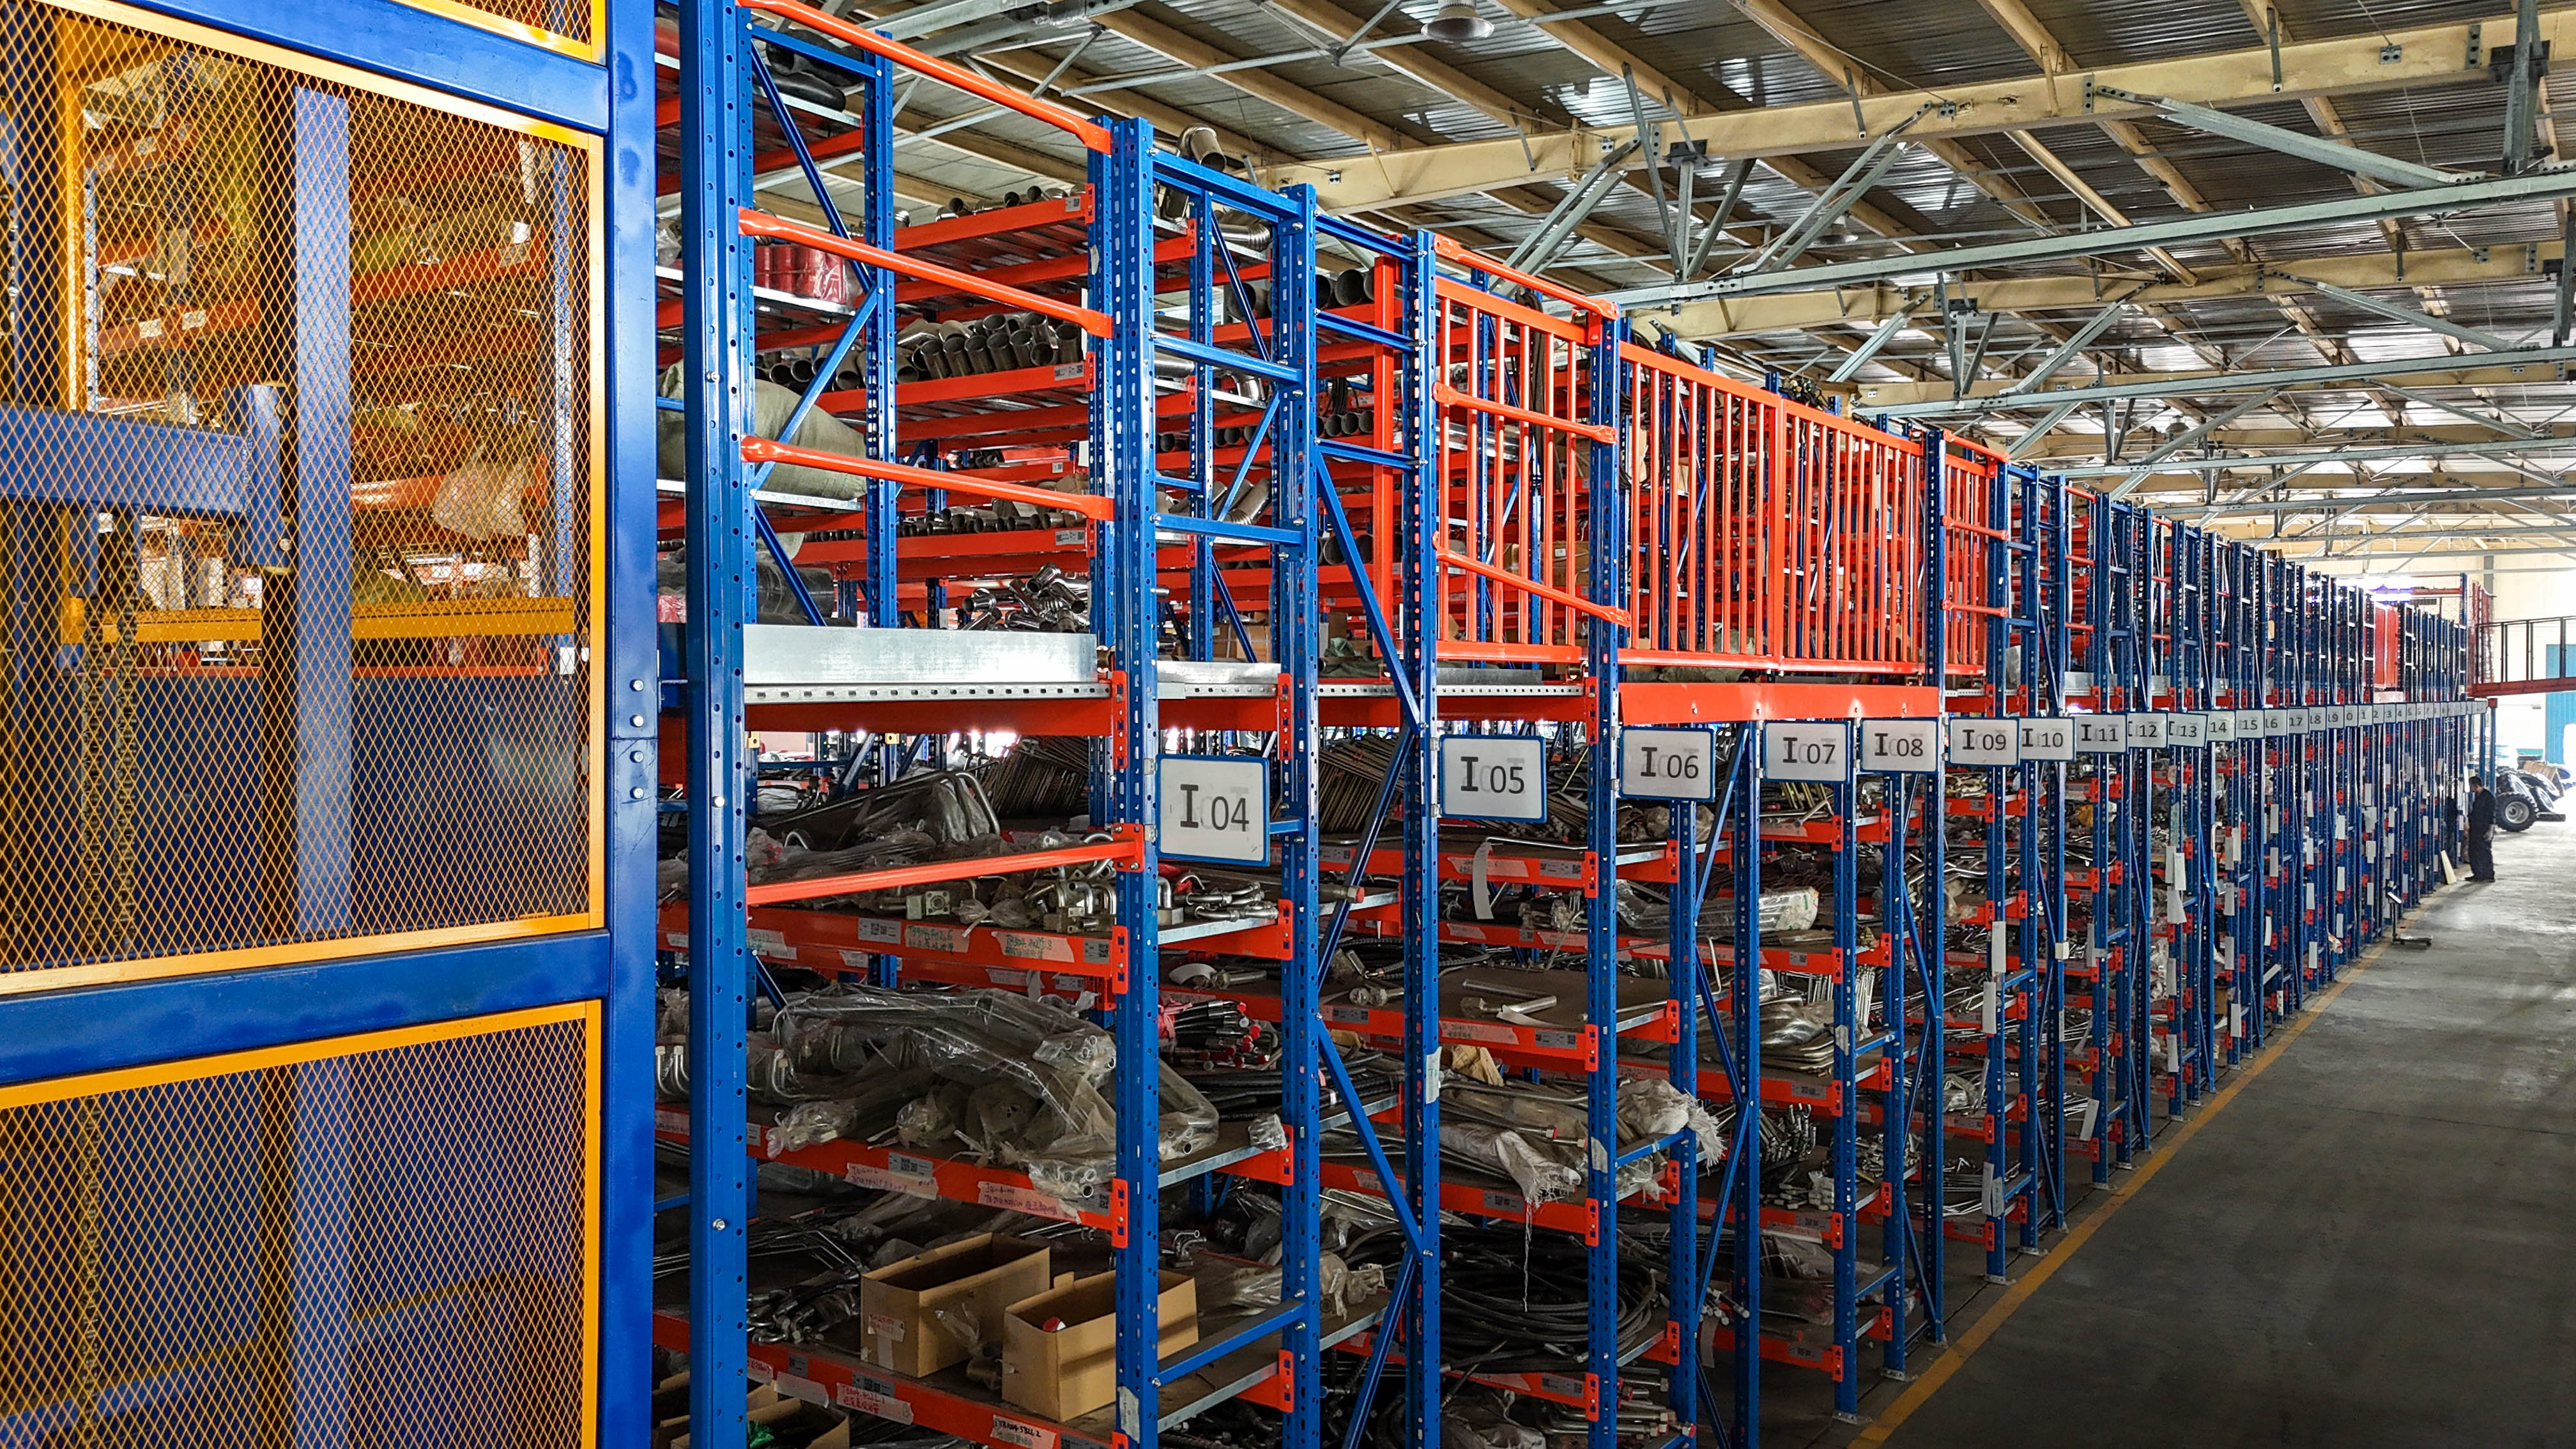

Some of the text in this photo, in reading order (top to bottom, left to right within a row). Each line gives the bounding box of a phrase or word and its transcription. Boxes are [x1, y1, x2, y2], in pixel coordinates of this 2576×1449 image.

[2209, 721, 2227, 733] 14
[2242, 719, 2258, 730] 15
[2288, 716, 2303, 727] 17
[2098, 728, 2119, 742] 11
[2138, 724, 2158, 738] 12
[2179, 724, 2198, 738] 13
[1896, 738, 1924, 757] 08
[1982, 733, 2007, 751] 09
[2041, 732, 2064, 748] 10
[1806, 743, 1836, 765] 07
[1666, 754, 1699, 779] 06
[1490, 765, 1525, 794] 05
[1211, 795, 1250, 832] 04
